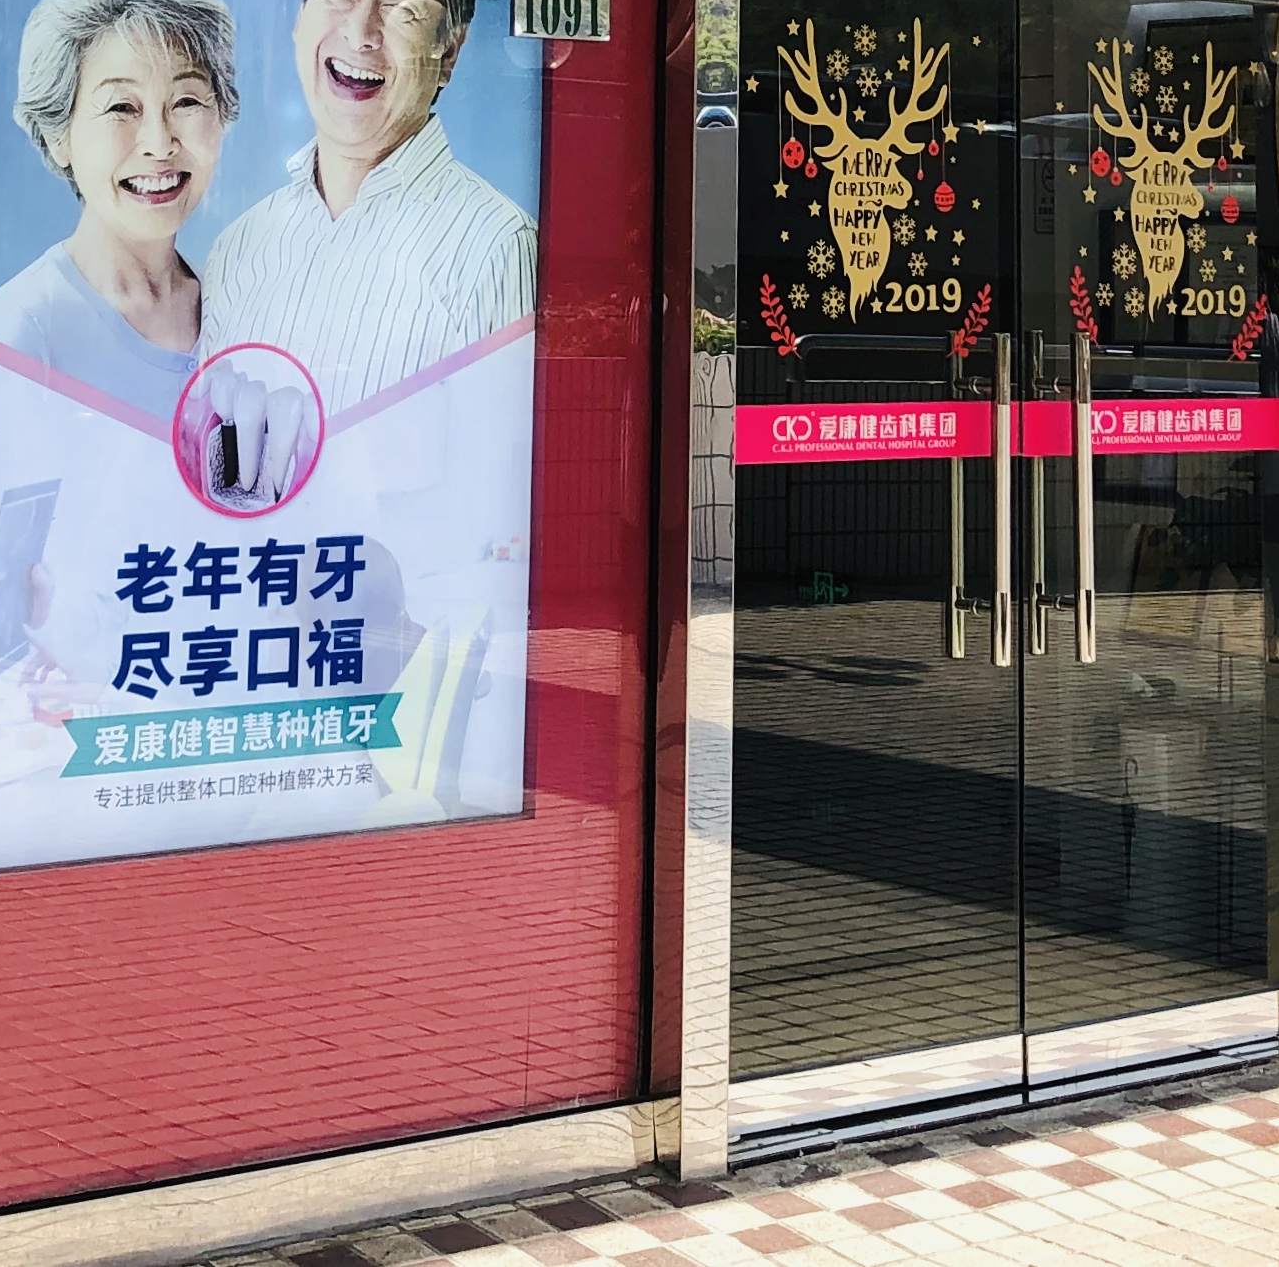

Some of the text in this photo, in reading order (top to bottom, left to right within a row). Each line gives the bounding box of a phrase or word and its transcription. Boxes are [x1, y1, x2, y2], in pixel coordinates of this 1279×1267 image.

[842, 147, 892, 178] MERRY
[1142, 160, 1186, 187] MERRY
[834, 181, 905, 197] CHRISTMAS
[1136, 190, 1198, 206] CHRISTMAS
[833, 207, 882, 229] HAPPY
[1135, 214, 1177, 236] HAPPY
[851, 232, 876, 246] NEW
[1150, 238, 1172, 251] NEW
[849, 250, 880, 270] YEAR
[1148, 255, 1176, 273] YEAR
[885, 277, 962, 313] 2019
[1180, 284, 1247, 318] 2019
[819, 412, 957, 441] 爱康健齿科集团
[1122, 408, 1242, 434] 爱康健齿科集团
[794, 441, 854, 452] PROFESSIONAL
[856, 440, 886, 451] DENTAL
[888, 439, 926, 449] HOSPITAL
[928, 438, 957, 448] GROUP
[115, 535, 366, 614] 老年有牙
[111, 618, 365, 700] 尽享口福
[93, 702, 377, 767] 爱康健智慧种植牙
[93, 763, 373, 810] 专注提供整体口腔种植解决方案
